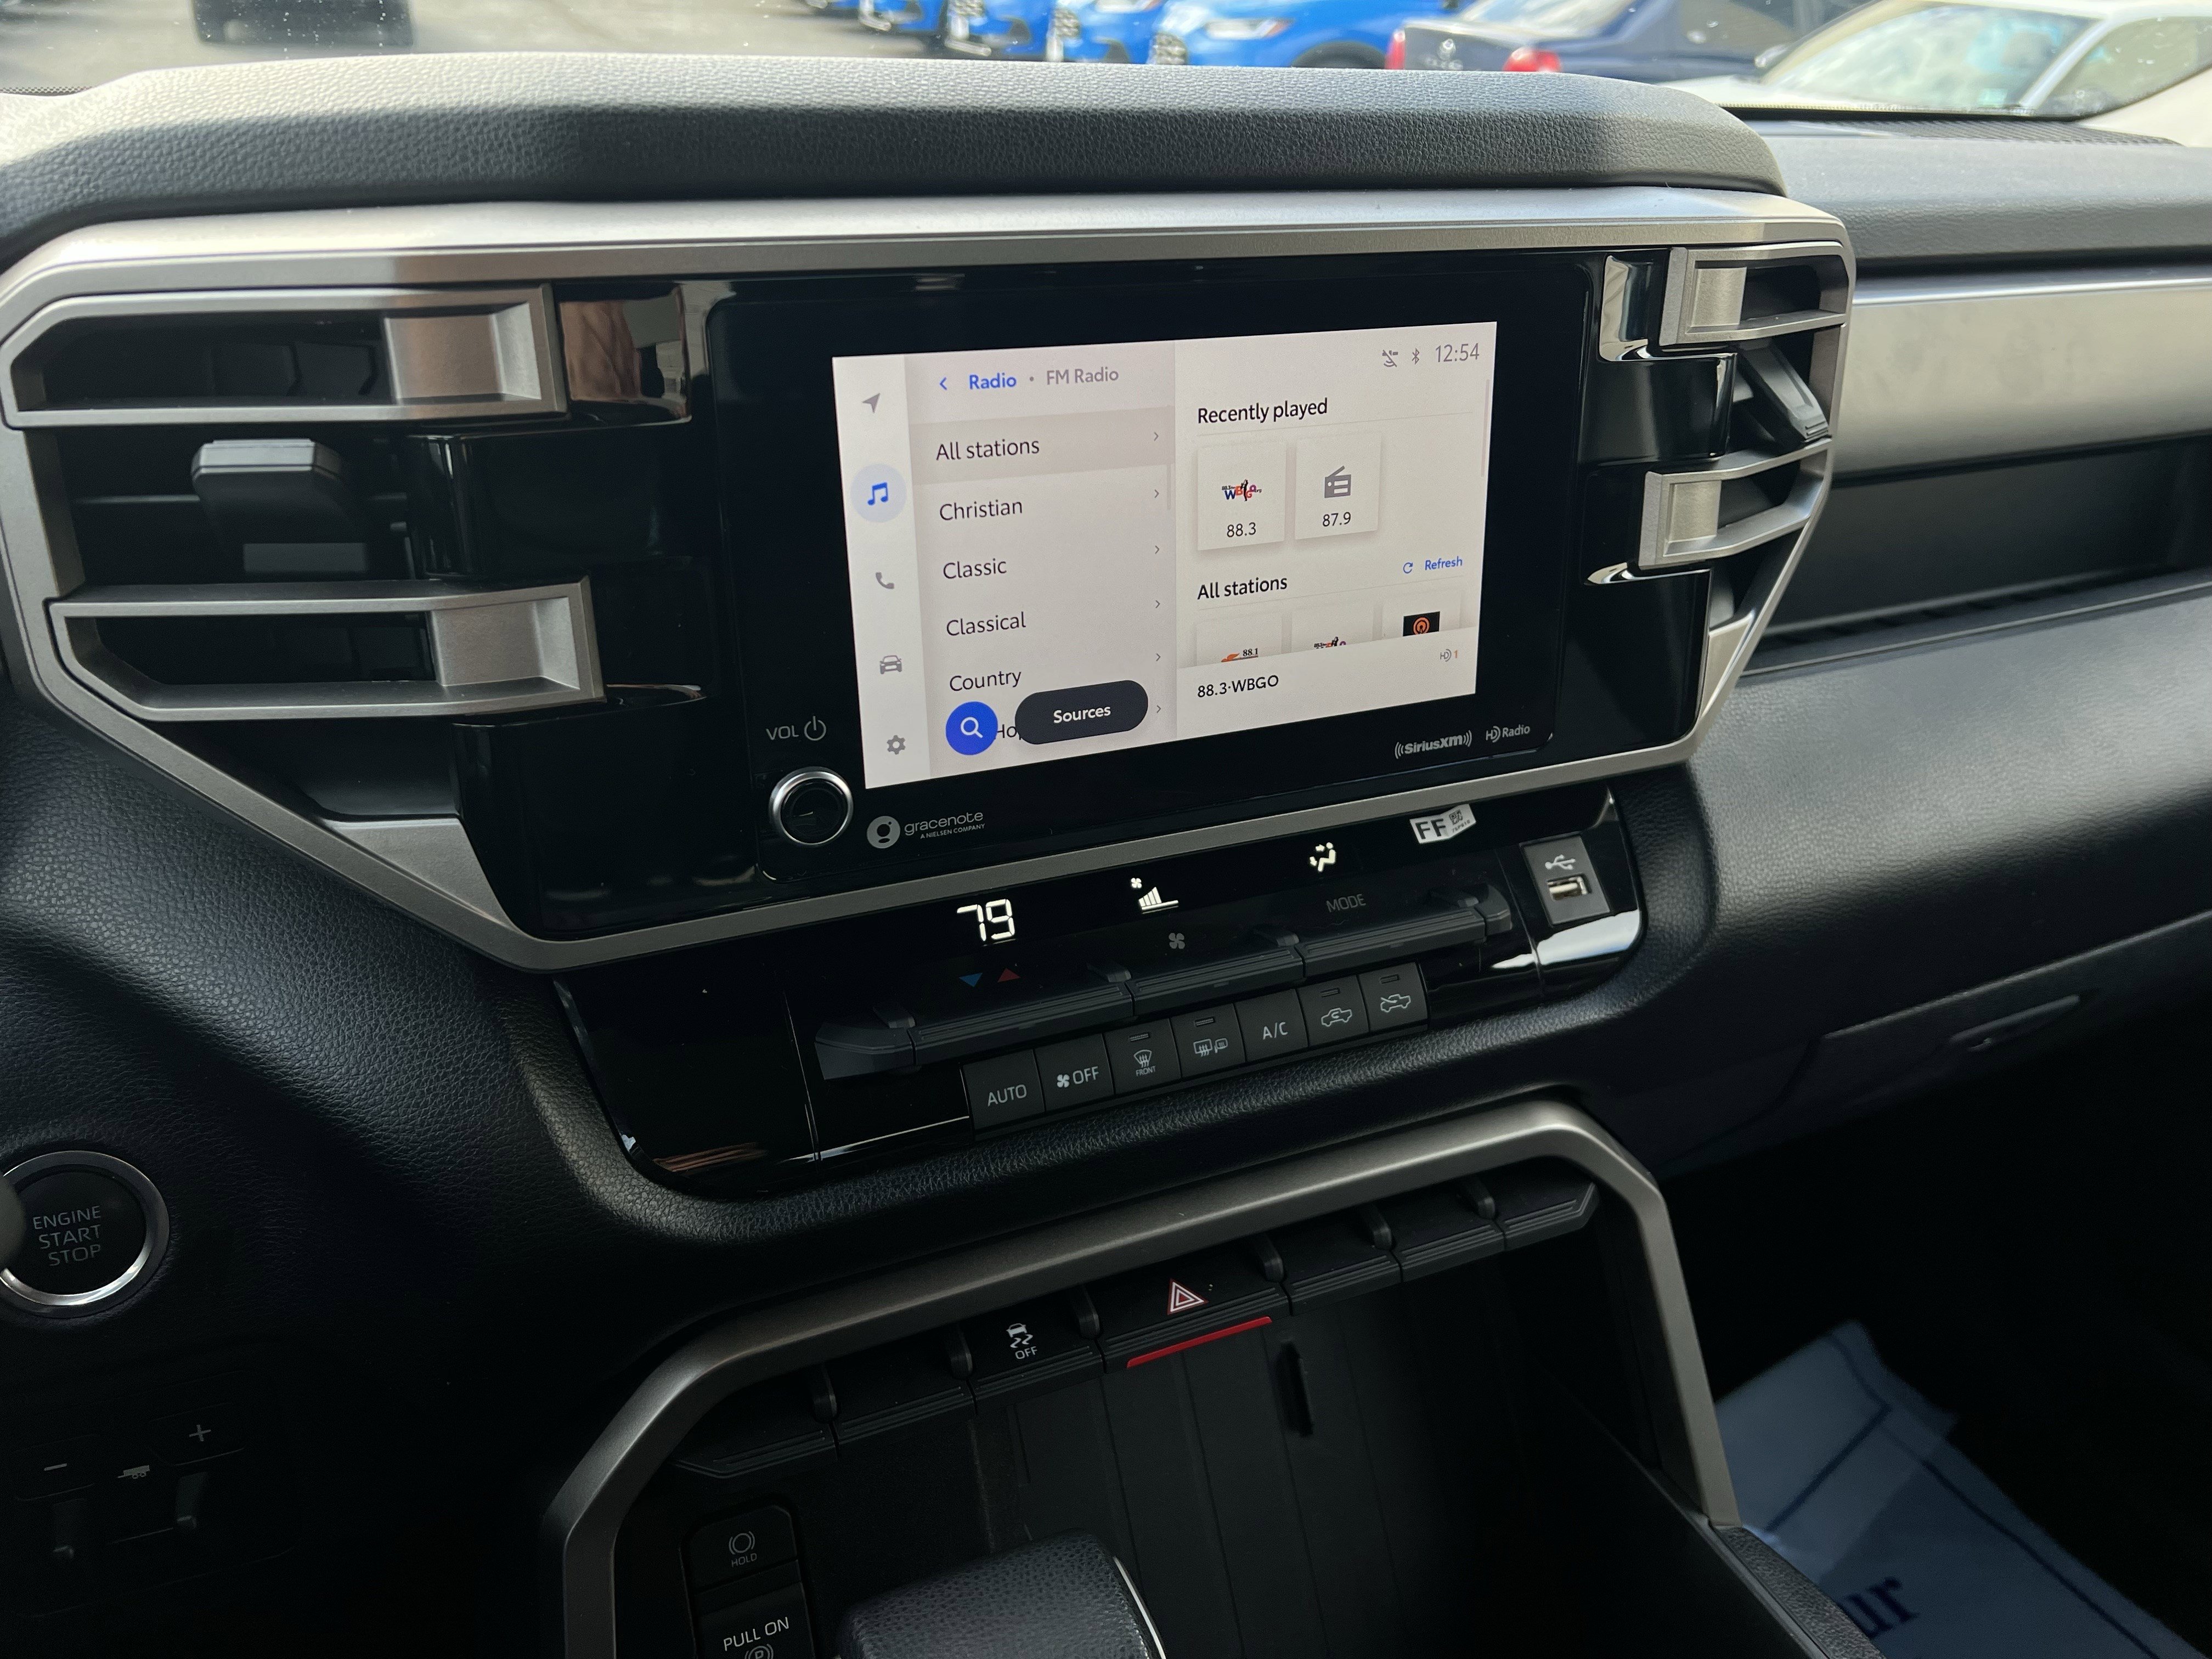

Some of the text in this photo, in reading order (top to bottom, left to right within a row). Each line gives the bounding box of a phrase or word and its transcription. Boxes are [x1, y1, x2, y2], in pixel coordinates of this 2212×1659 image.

[1436, 343, 1479, 362] 12:54
[969, 373, 1017, 390] Radio
[1047, 366, 1119, 385] FM Radio
[1199, 398, 1327, 424] Recently played
[936, 439, 1039, 460] All stations
[940, 500, 1022, 520] Christian
[1323, 512, 1351, 527] 87.9
[1227, 522, 1256, 538] 88.3
[944, 558, 1006, 579] Classic
[1425, 556, 1462, 570] Refresh
[1198, 577, 1287, 600] All stations
[947, 612, 1026, 636] Classical
[1242, 648, 1259, 657] 88.1
[950, 671, 1021, 691] Country
[1054, 707, 1110, 723] Sources
[766, 725, 799, 740] VOL
[1502, 725, 1530, 737] Radio
[904, 812, 984, 836] gracenote
[926, 829, 952, 838] NIELSEN
[953, 823, 985, 833] COMPANY
[1415, 818, 1446, 839] FF
[1327, 894, 1366, 912] MODE
[956, 898, 1016, 941] 79
[1263, 1022, 1288, 1039] A/C
[1073, 1066, 1098, 1084] OFF
[1136, 1065, 1155, 1076] FRONT
[988, 1085, 1026, 1106] AUTO
[33, 1205, 101, 1230] ENGINE
[38, 1224, 101, 1250] START
[48, 1244, 101, 1266] STOP
[1015, 1346, 1038, 1359] OFF
[731, 1553, 757, 1567] HOLD
[723, 1617, 789, 1651] PULL ON
